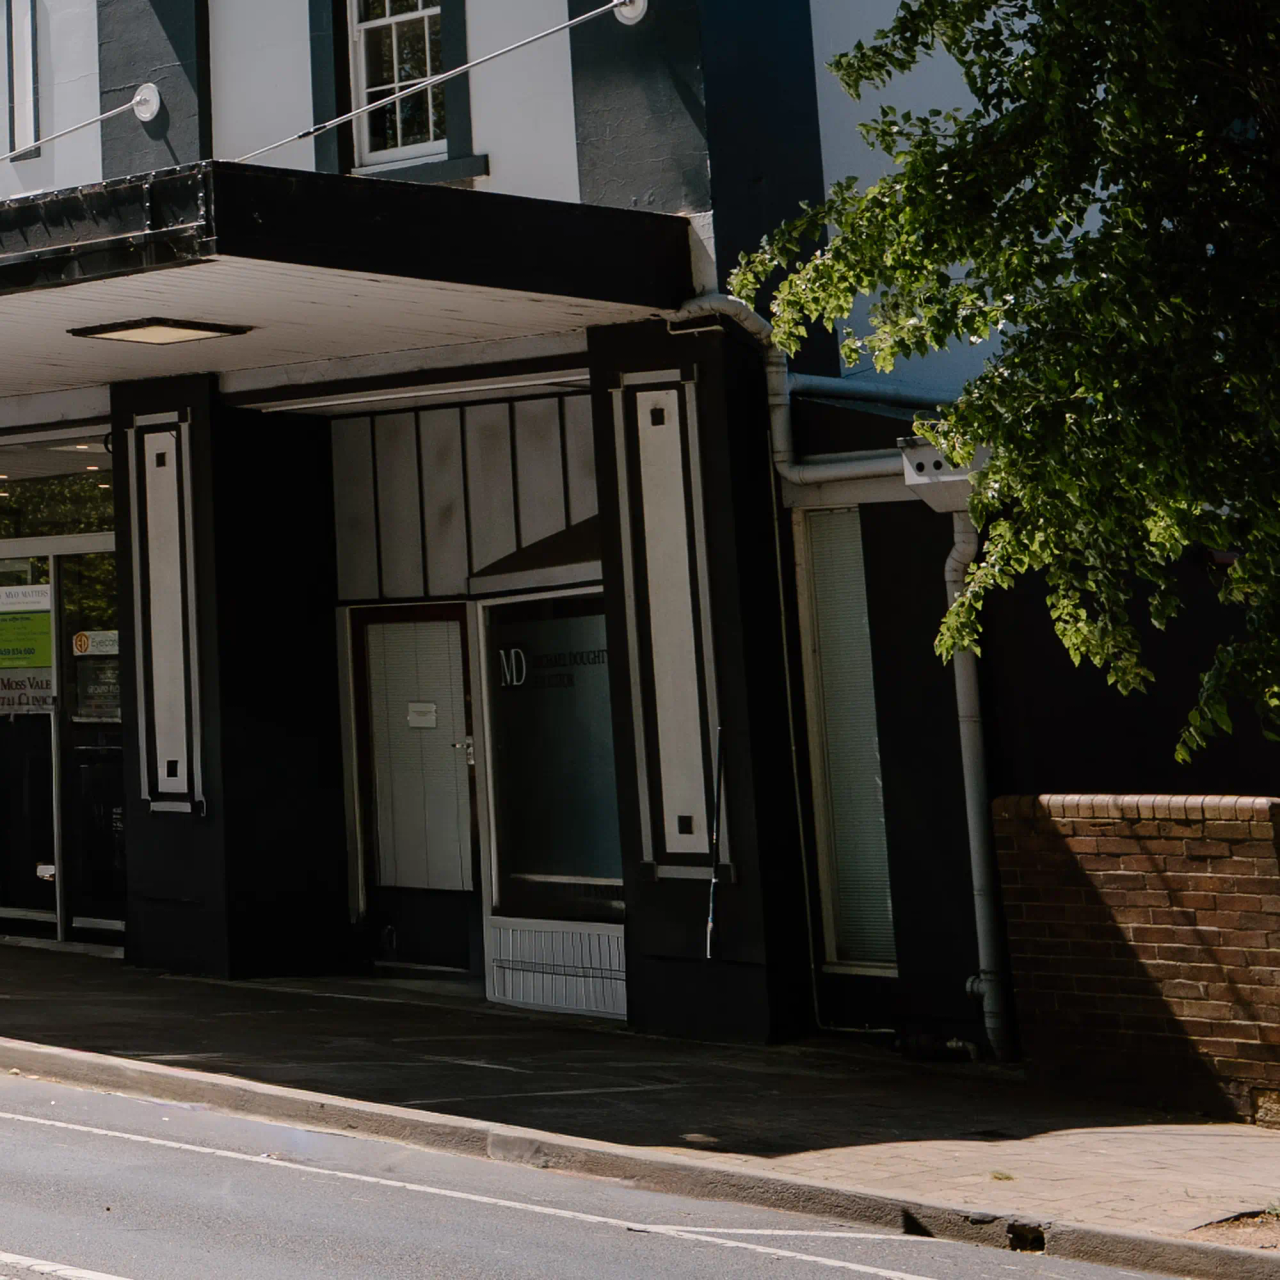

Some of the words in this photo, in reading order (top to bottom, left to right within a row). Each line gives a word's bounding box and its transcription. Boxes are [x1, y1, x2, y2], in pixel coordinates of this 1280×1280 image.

[21, 589, 48, 598] MATTERS
[499, 648, 527, 687] MD
[0, 677, 26, 691] MOSS
[27, 676, 52, 690] VALE
